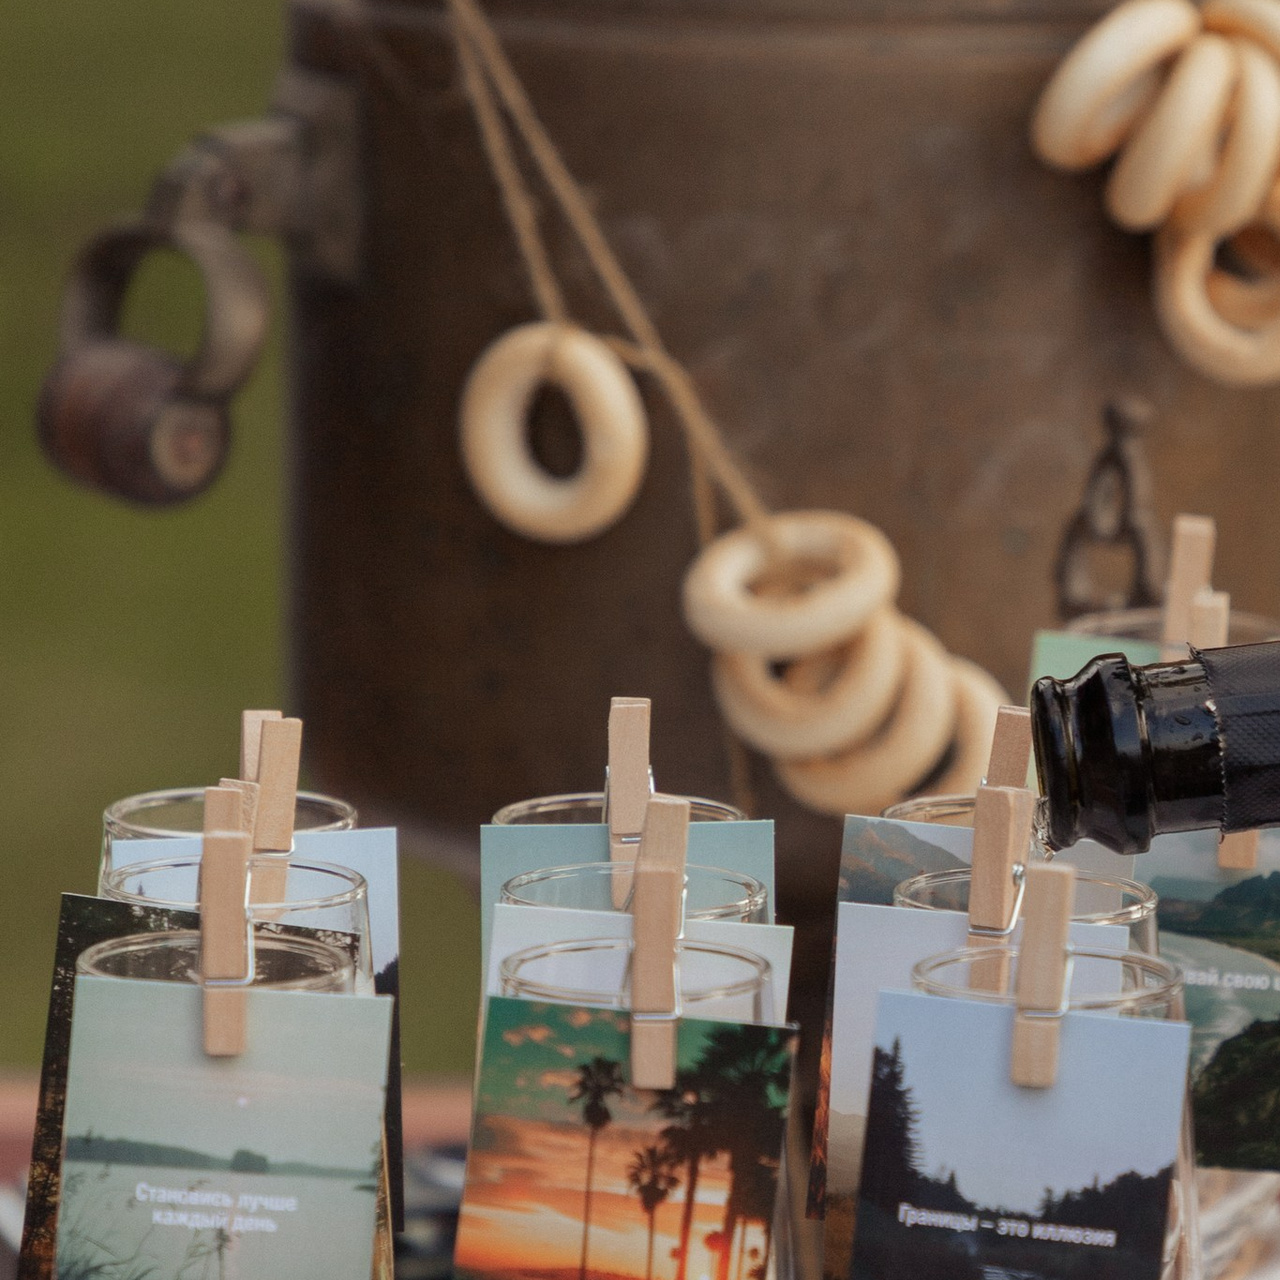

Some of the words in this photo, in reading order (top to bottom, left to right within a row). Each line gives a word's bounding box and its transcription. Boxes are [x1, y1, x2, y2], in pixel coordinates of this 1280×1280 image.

[1222, 972, 1271, 990] свою
[135, 1181, 234, 1208] Становись
[237, 1192, 298, 1213] лучше
[152, 1209, 230, 1230] каждый
[231, 1215, 279, 1233] день
[898, 1201, 980, 1233] Границы
[996, 1218, 1031, 1238] это
[1031, 1221, 1118, 1248] иллюзия
